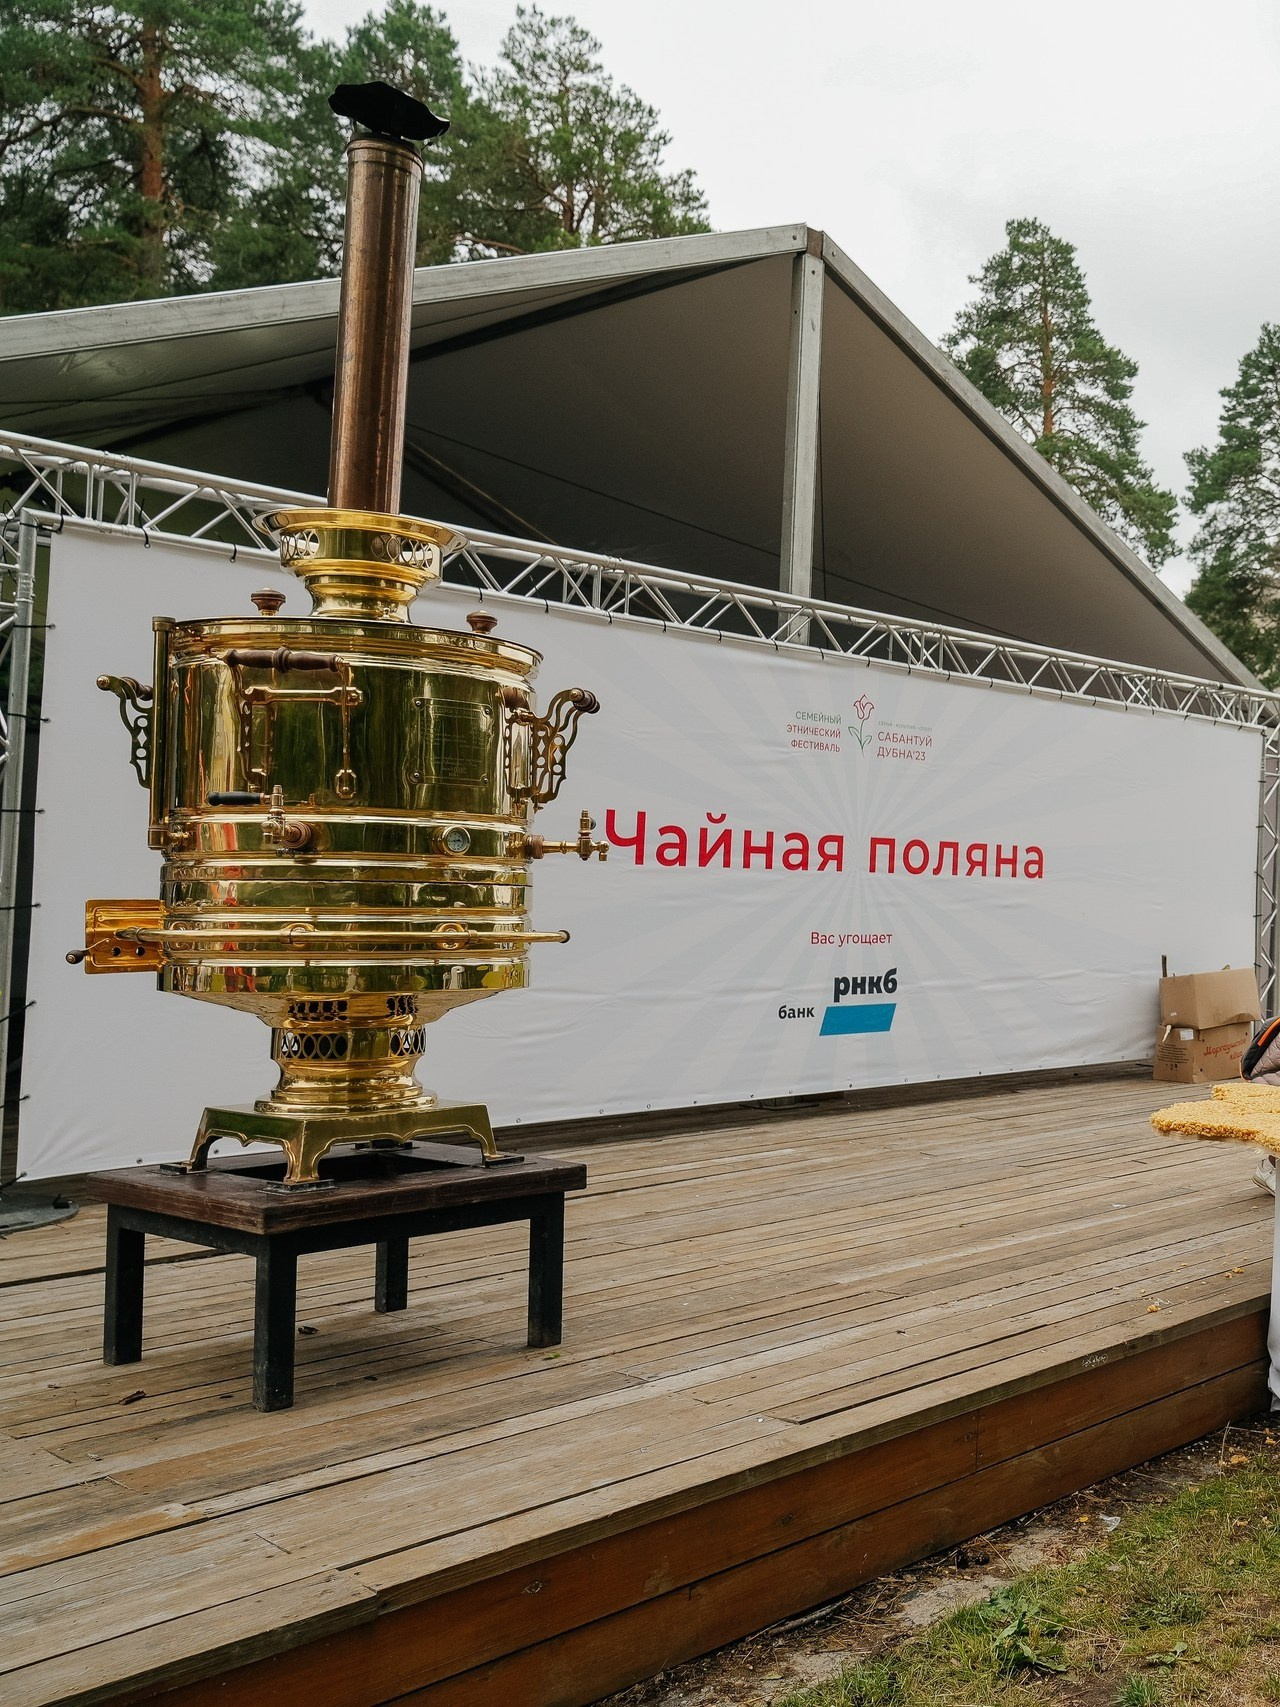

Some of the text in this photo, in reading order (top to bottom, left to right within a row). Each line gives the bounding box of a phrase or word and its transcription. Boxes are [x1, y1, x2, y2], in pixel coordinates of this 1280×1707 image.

[795, 710, 842, 724] СЕМЕЙНЫЙ
[786, 724, 841, 739] ЭТНИЧЕСКИЙ
[877, 731, 933, 747] САБАНТУЙ
[790, 739, 841, 753] ФЕСТИВАЛЬ
[877, 746, 926, 761] ДУБНА'23
[605, 808, 1045, 879] Чайная поляна
[810, 931, 893, 948] Вас угощает
[833, 968, 898, 1003] рнкб
[778, 1003, 816, 1020] банк
